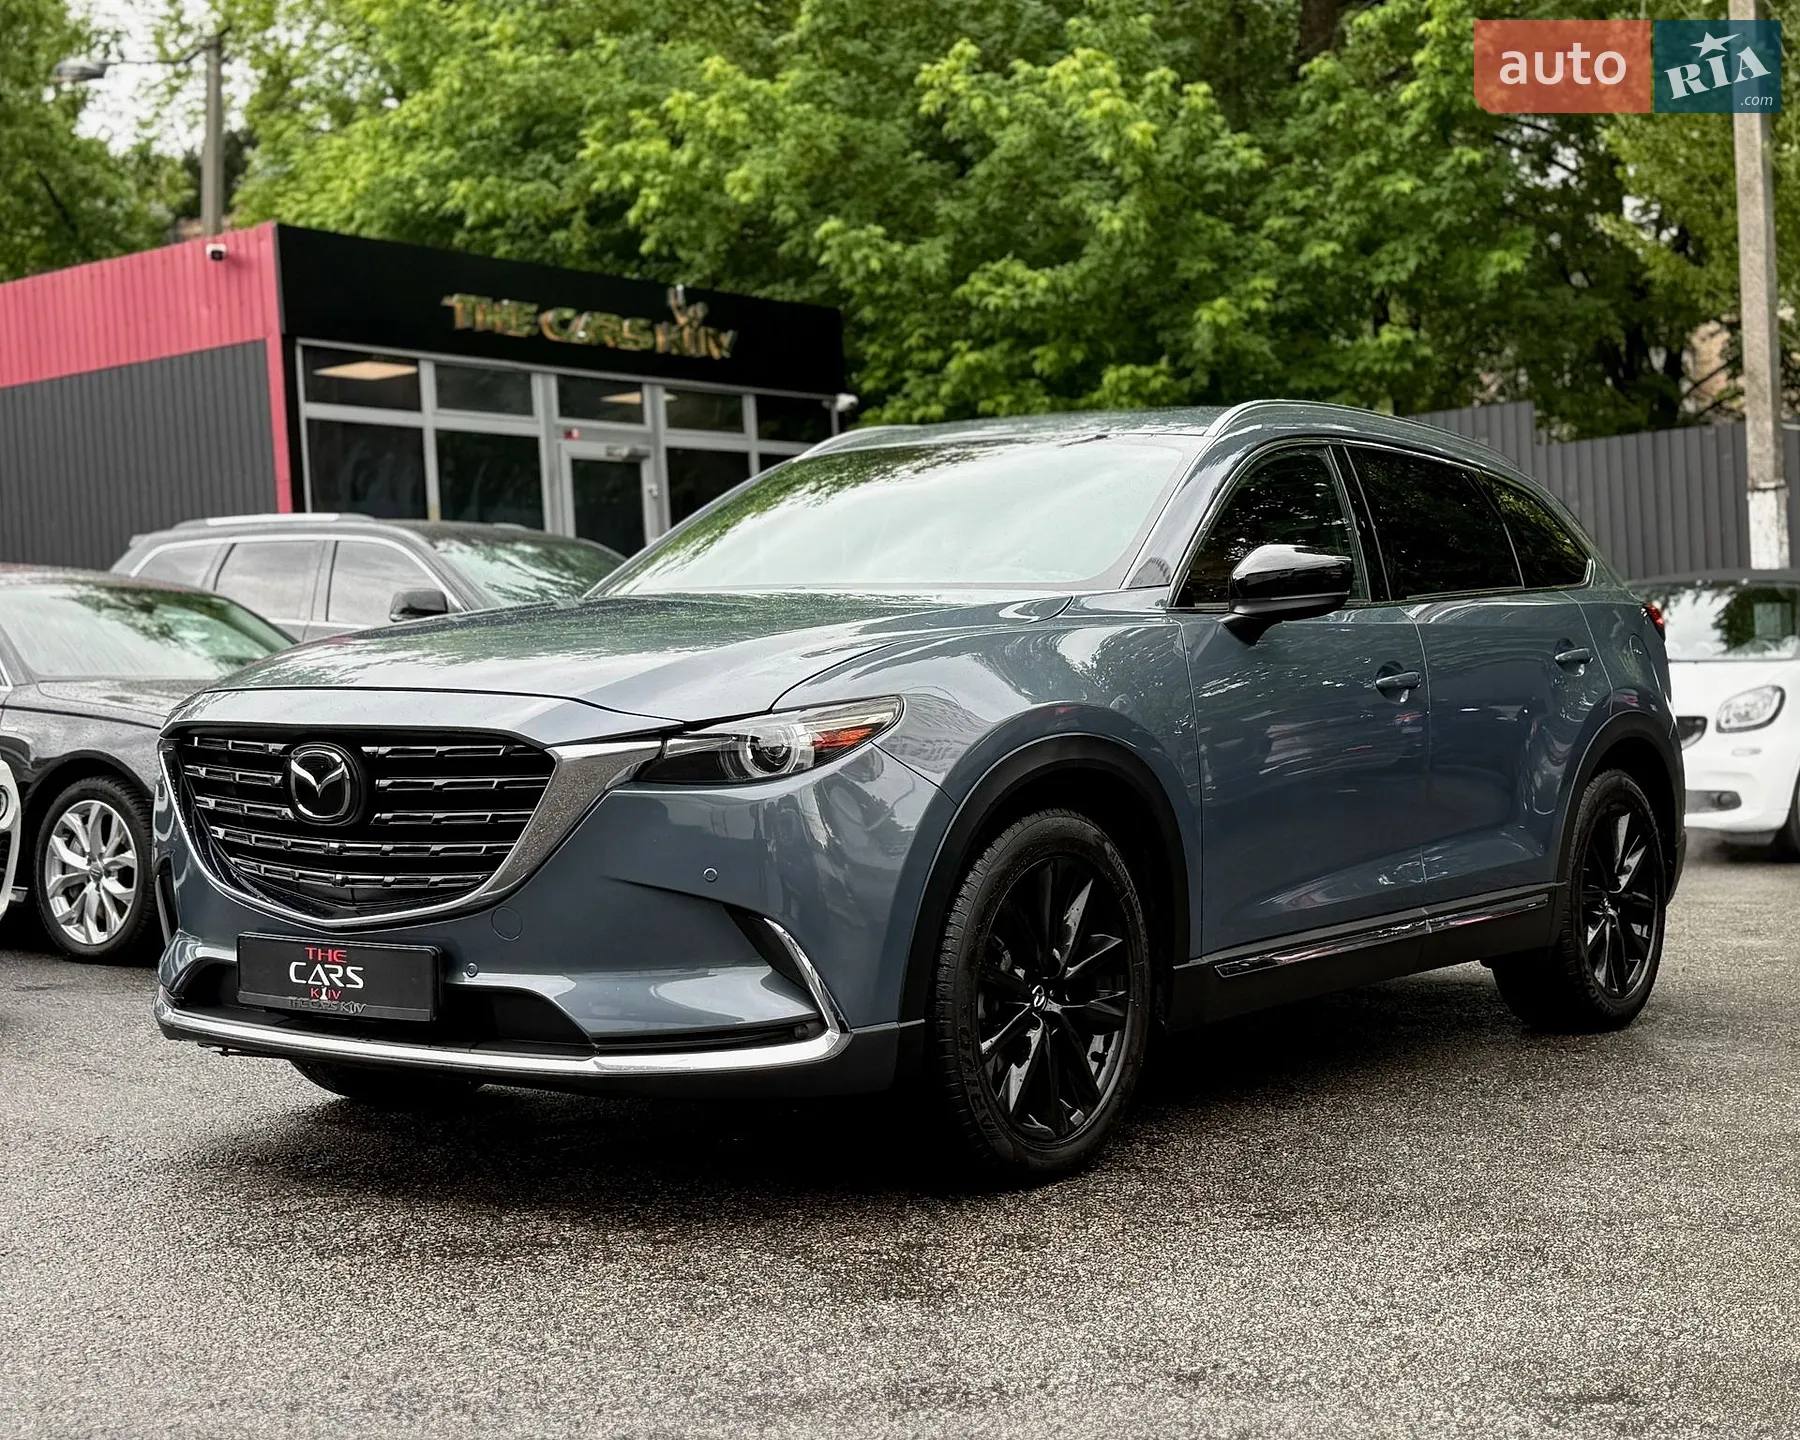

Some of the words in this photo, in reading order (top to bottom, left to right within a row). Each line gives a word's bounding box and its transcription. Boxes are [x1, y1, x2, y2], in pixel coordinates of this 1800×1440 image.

[441, 293, 538, 337] THE
[539, 307, 655, 350] CARS
[304, 947, 347, 963] THE
[289, 961, 364, 989] CARS
[287, 996, 309, 1008] THE
